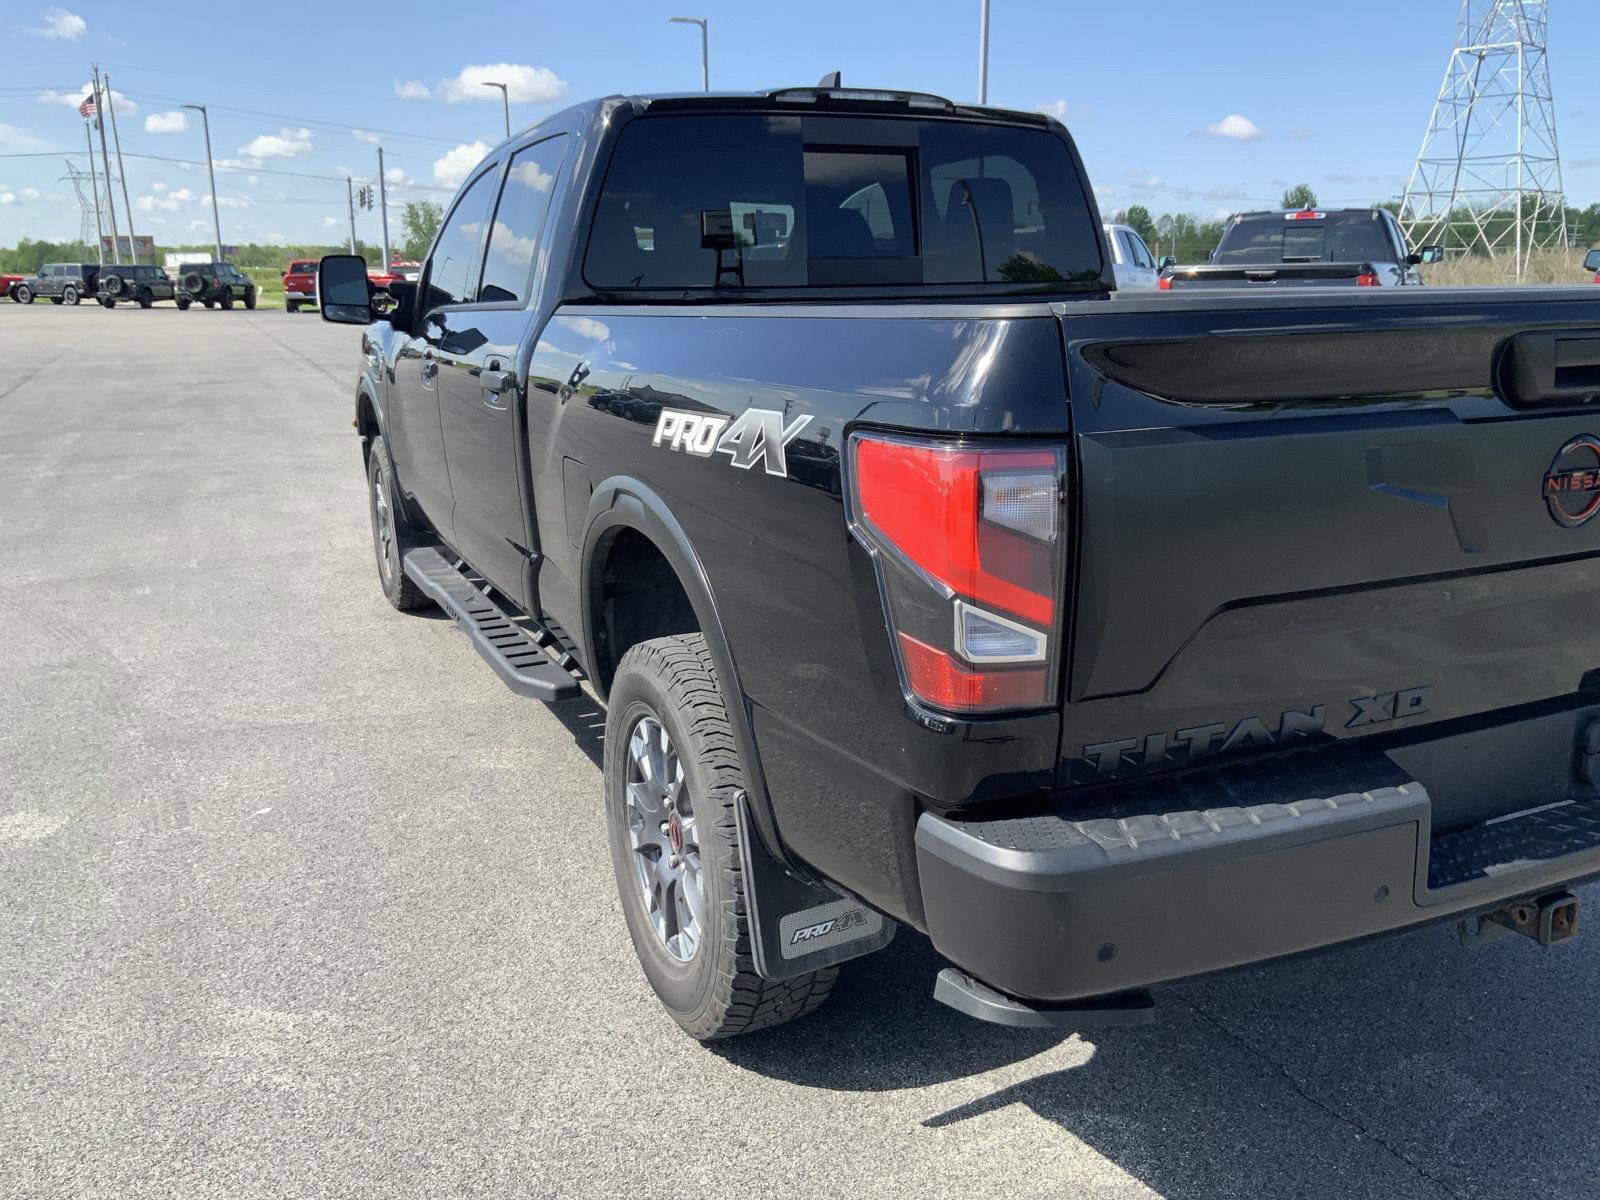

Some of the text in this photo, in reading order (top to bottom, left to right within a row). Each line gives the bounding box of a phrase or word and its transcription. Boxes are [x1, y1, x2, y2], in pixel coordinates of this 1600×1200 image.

[1547, 470, 1600, 491] NISSA
[1082, 686, 1434, 772] TITAN XD
